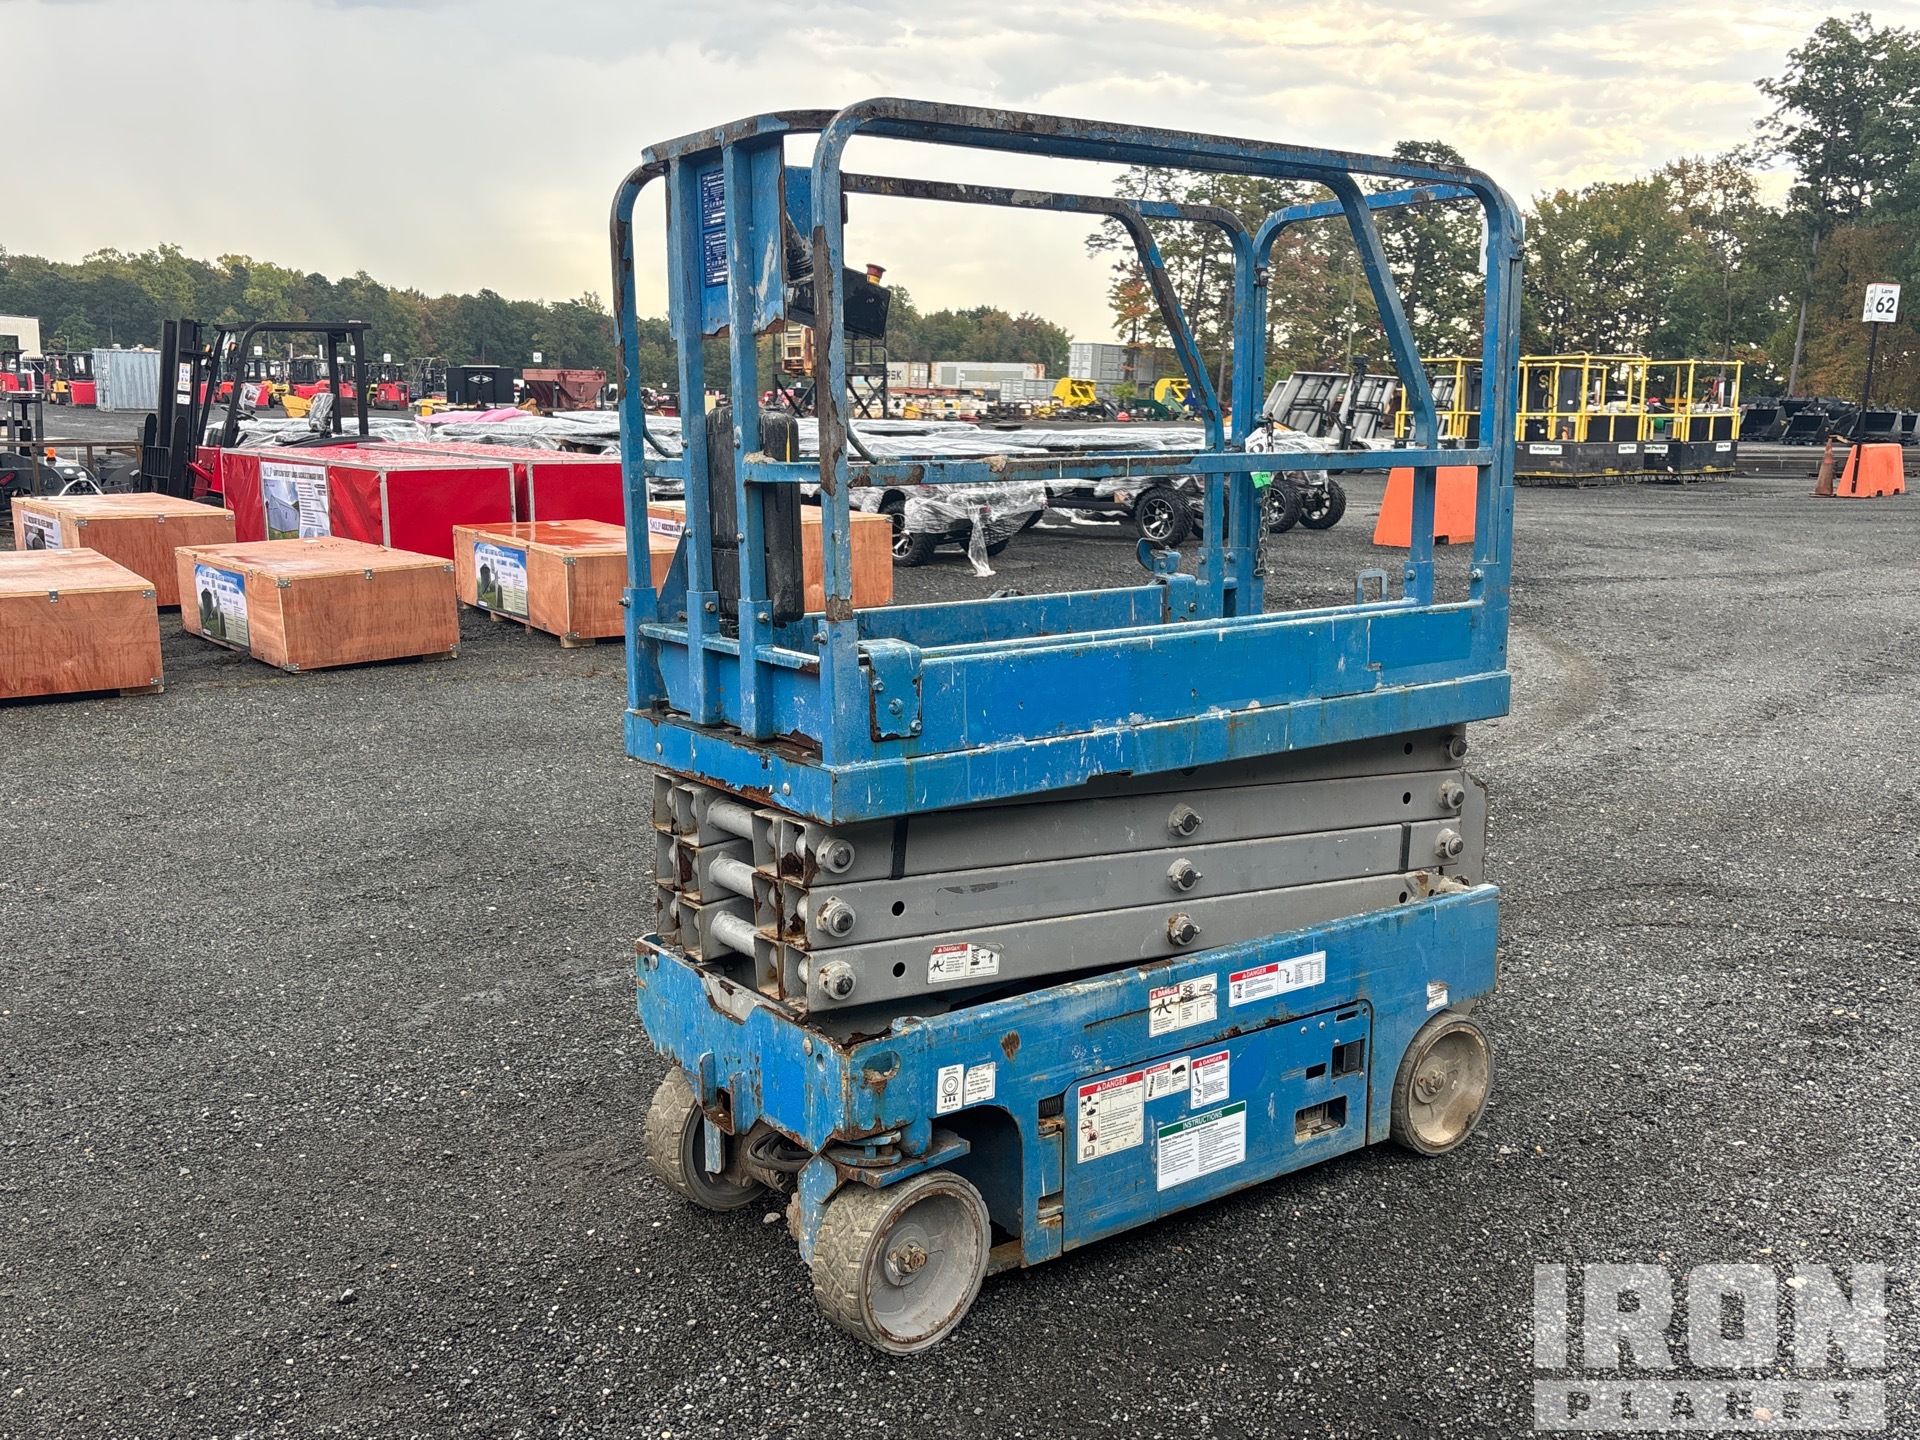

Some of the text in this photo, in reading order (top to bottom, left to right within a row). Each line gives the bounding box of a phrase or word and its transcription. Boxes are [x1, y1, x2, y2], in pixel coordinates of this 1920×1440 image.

[1875, 296, 1895, 313] 62
[1246, 967, 1267, 978] DANGER
[1157, 987, 1178, 997] DANGER
[1203, 1055, 1223, 1065] DANGER
[1151, 1064, 1168, 1073] DANGER
[1102, 1077, 1127, 1090] DANGER
[1182, 1111, 1223, 1130] INSTRUCTIONS
[1184, 1128, 1200, 1136] Operating
[1199, 1122, 1219, 1130] Instructions
